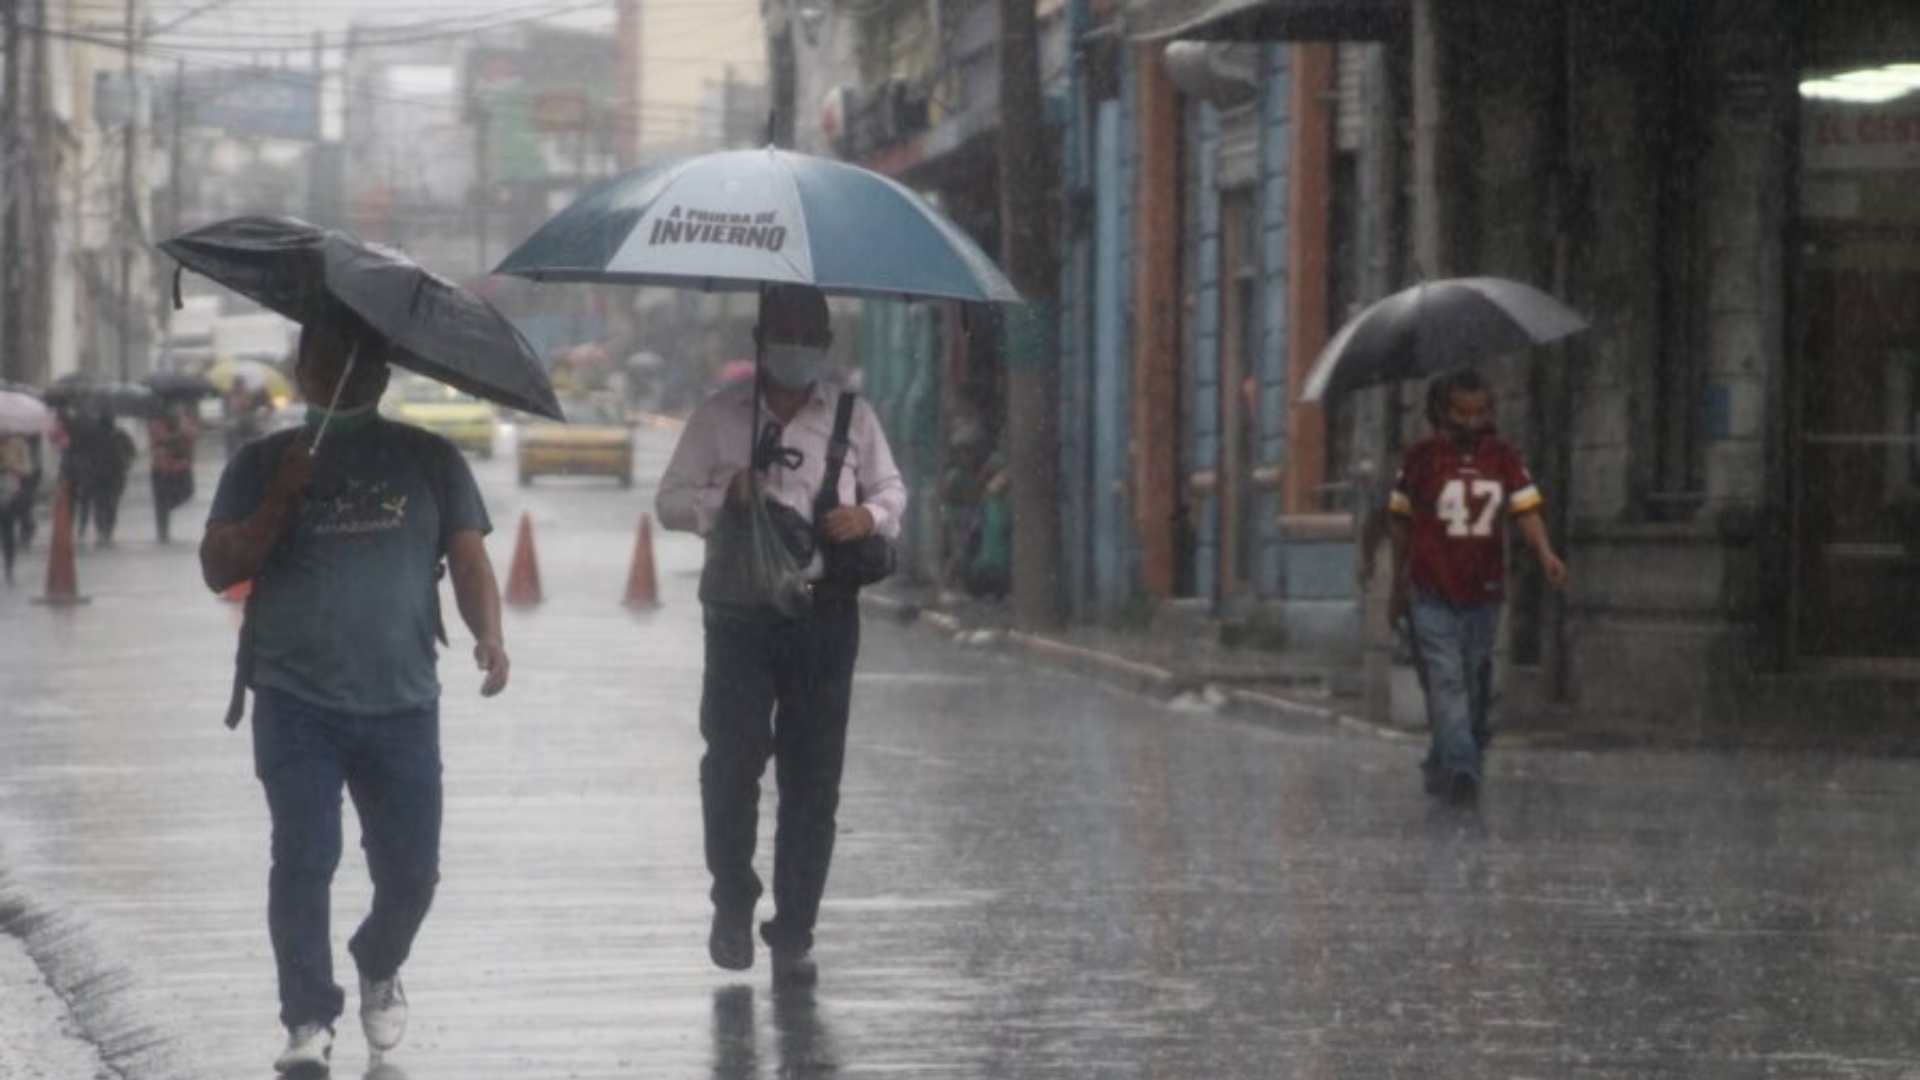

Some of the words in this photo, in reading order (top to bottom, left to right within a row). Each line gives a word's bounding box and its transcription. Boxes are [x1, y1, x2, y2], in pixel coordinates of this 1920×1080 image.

[669, 205, 682, 219] A
[686, 208, 751, 224] PRUEBA
[754, 210, 777, 224] DE
[649, 218, 787, 252] INVIERNO
[1437, 479, 1504, 537] 47
